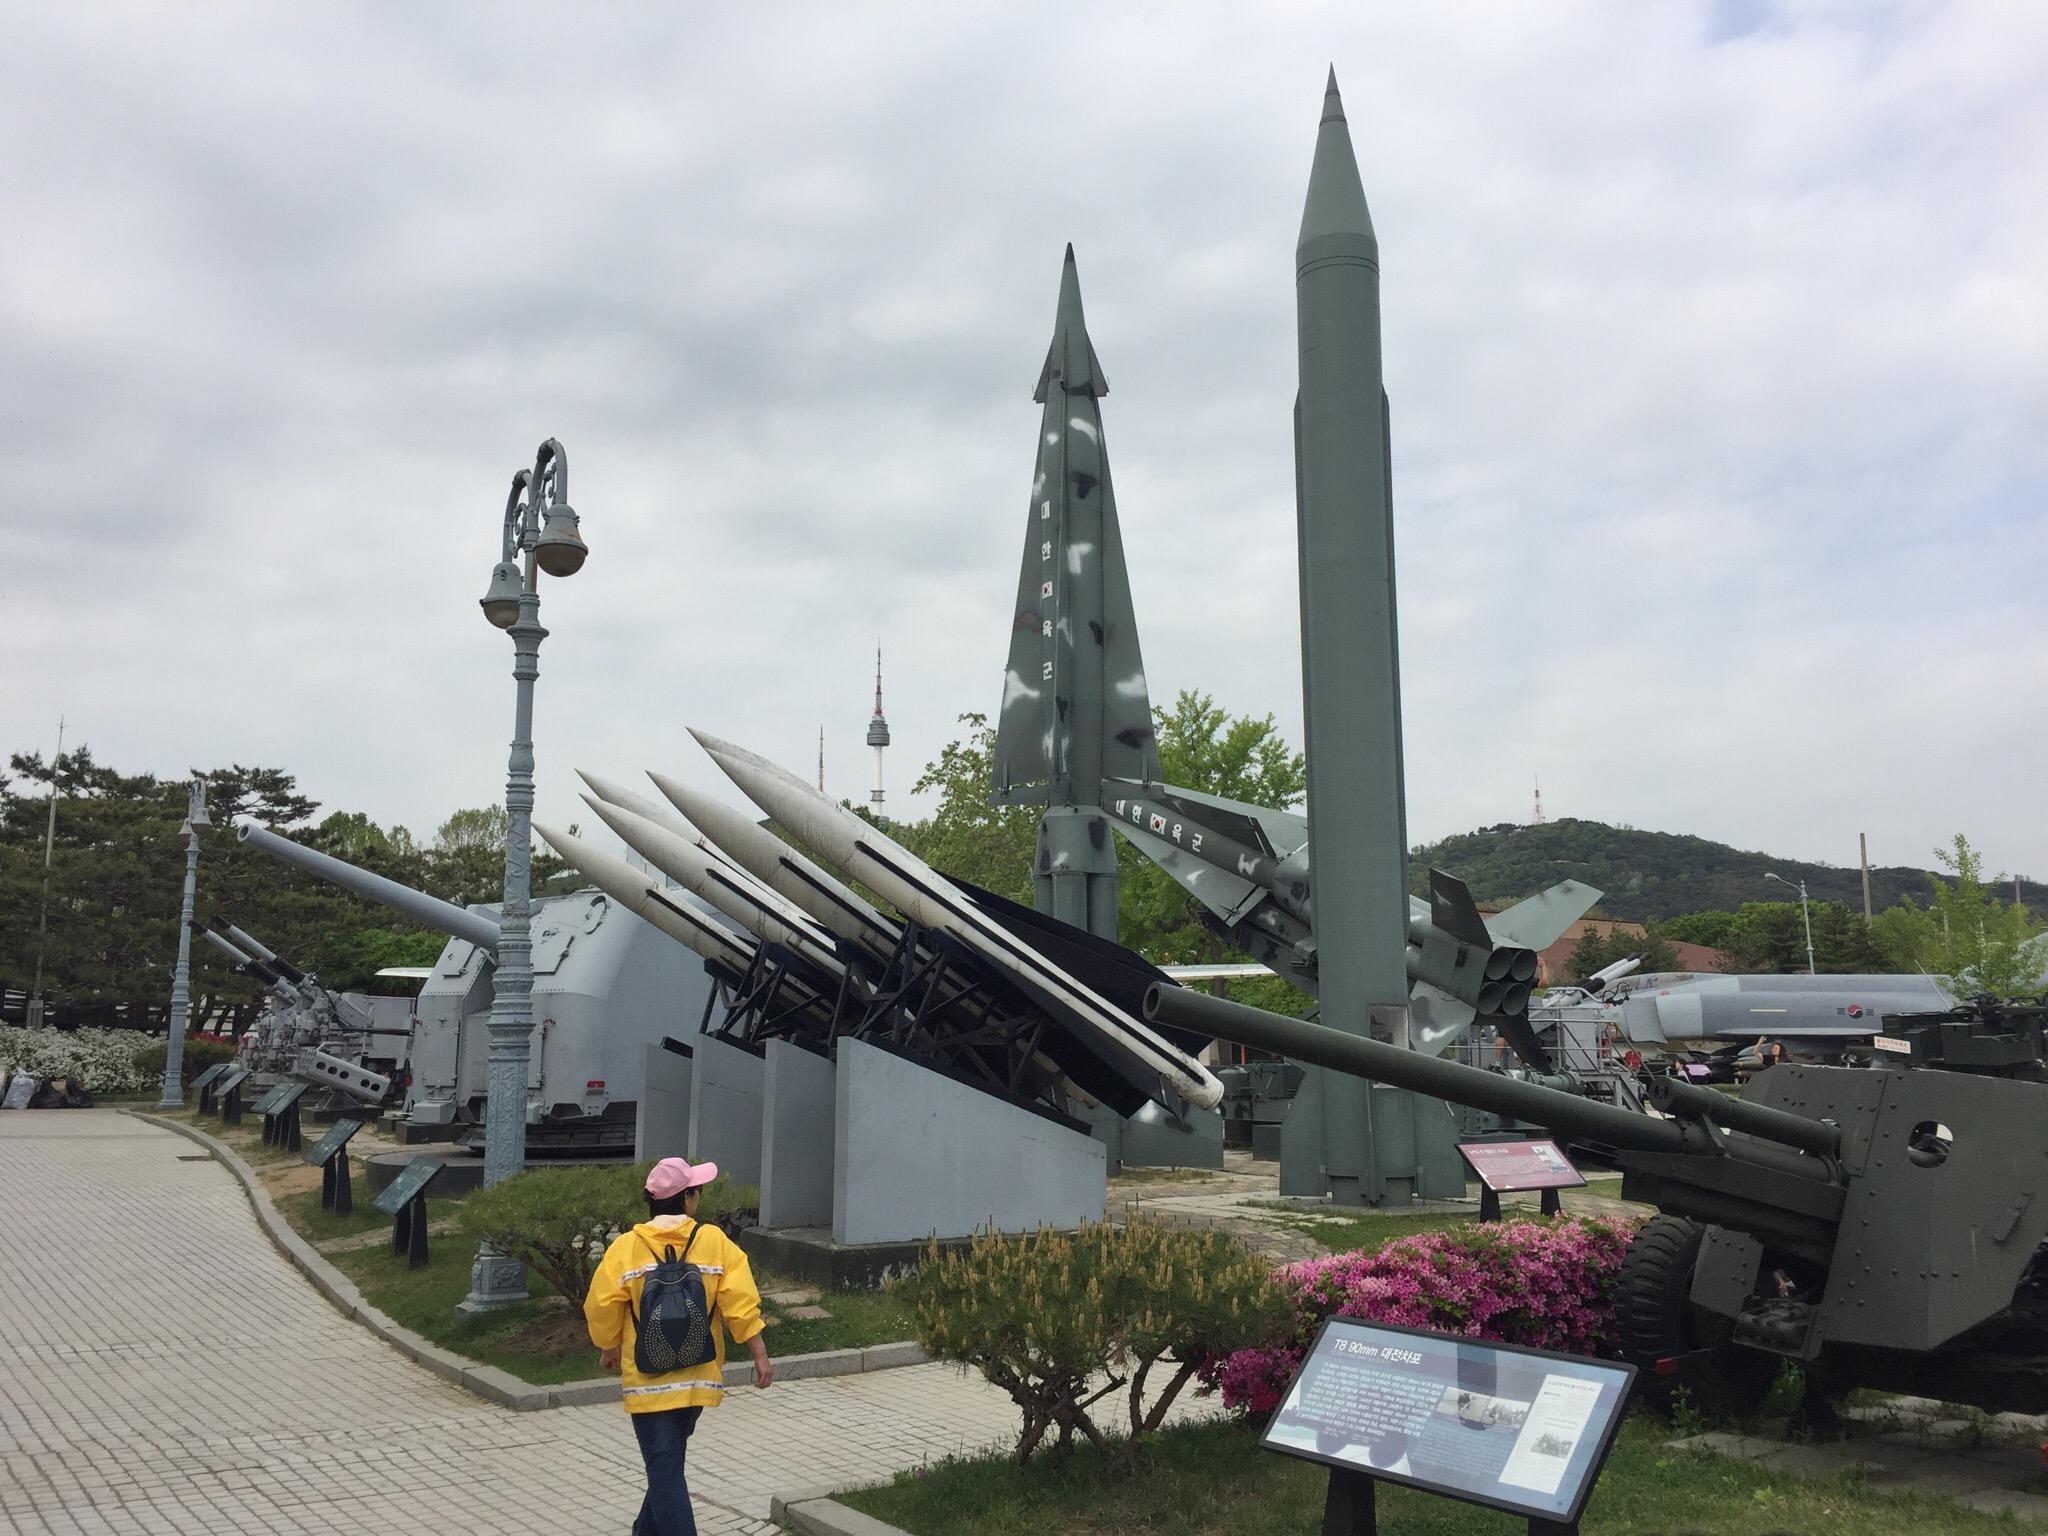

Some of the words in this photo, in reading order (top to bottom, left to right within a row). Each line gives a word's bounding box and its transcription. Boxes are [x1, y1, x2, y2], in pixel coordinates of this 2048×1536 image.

[1334, 1338, 1348, 1351] T8
[1348, 1341, 1379, 1358] 90mm
[1381, 1346, 1423, 1365] 대전차포
